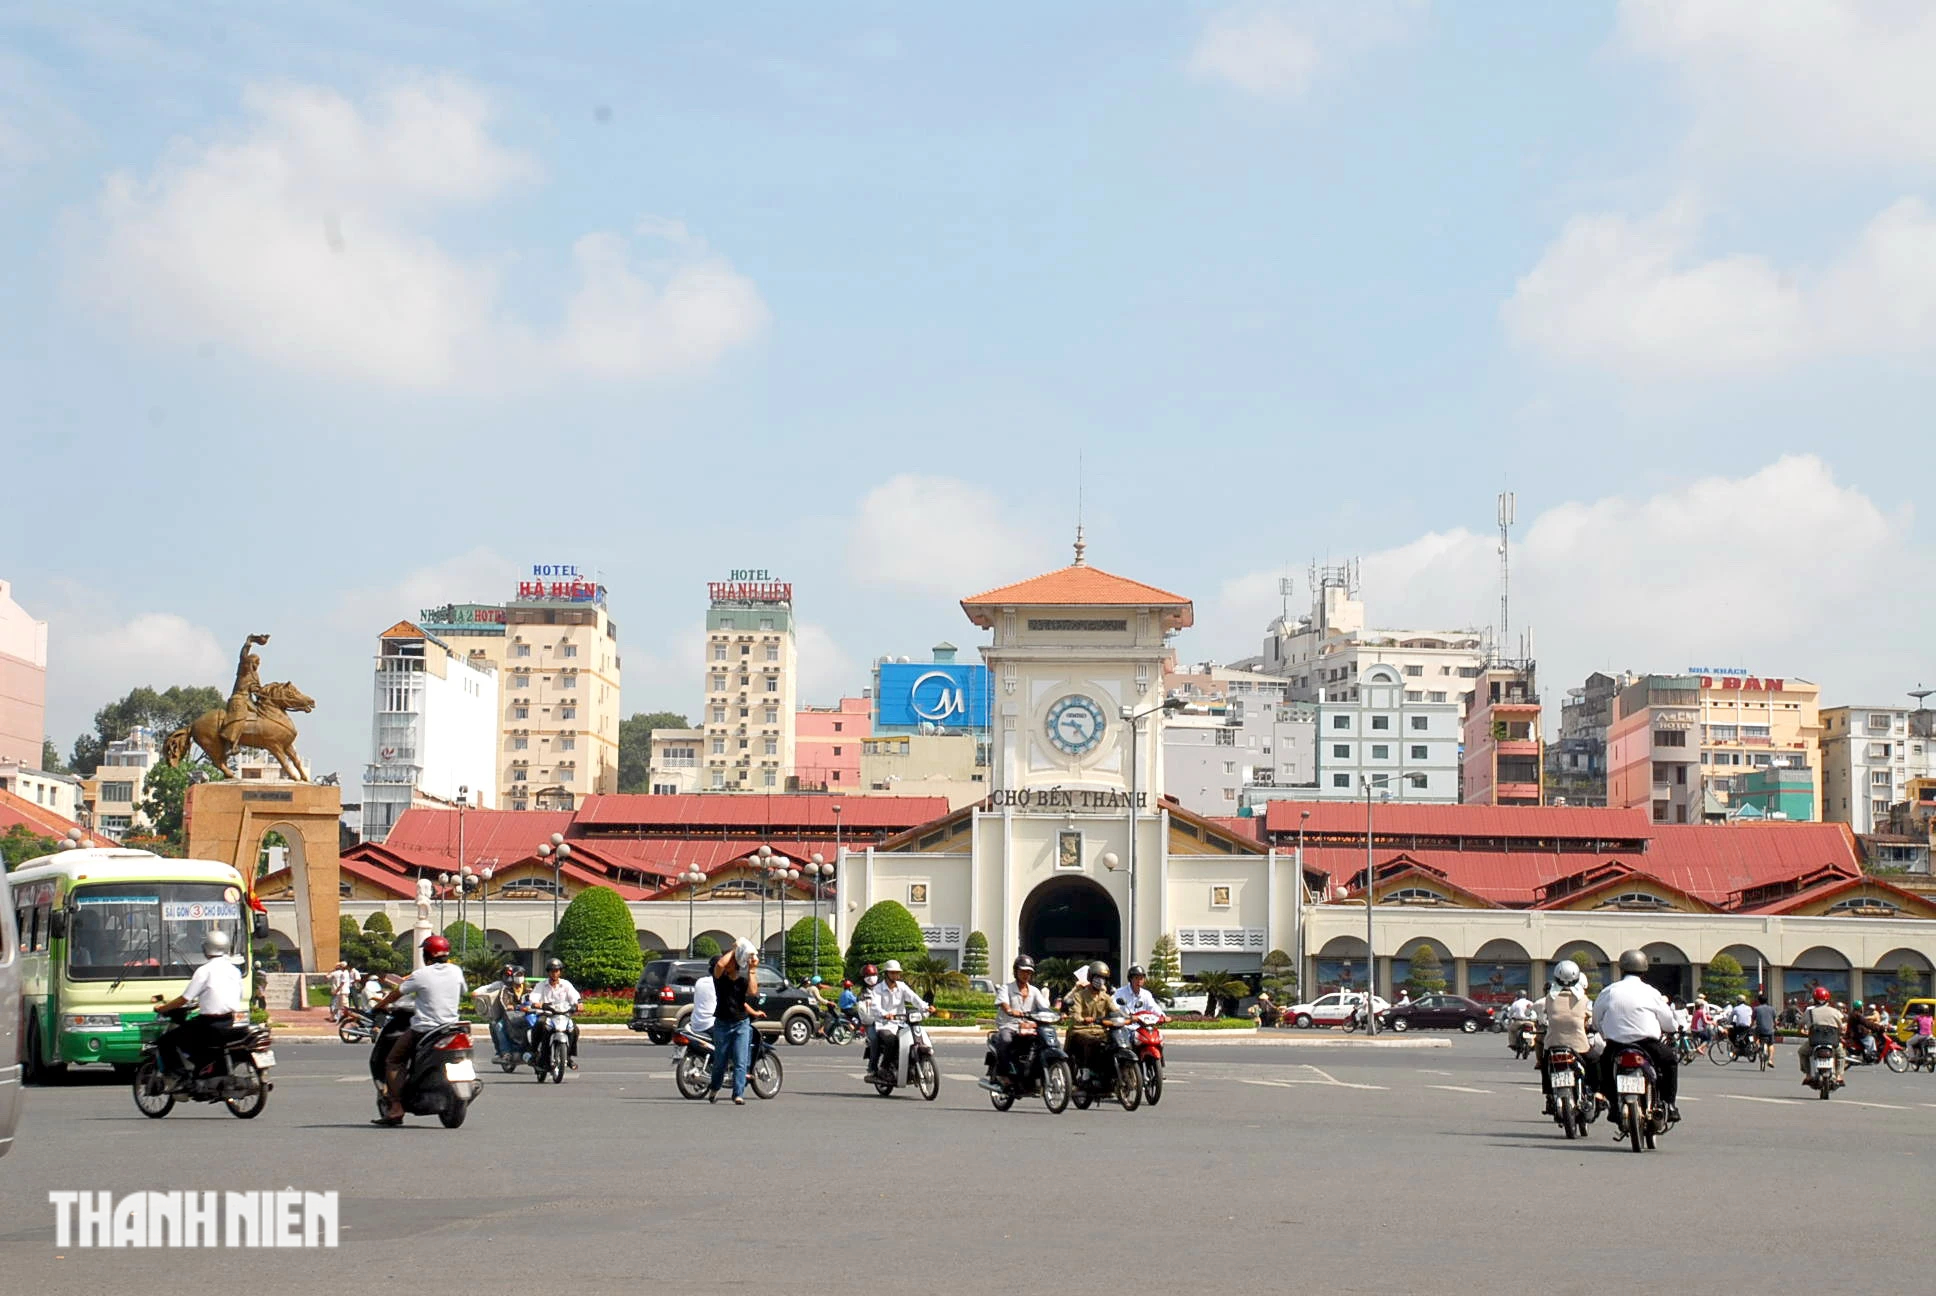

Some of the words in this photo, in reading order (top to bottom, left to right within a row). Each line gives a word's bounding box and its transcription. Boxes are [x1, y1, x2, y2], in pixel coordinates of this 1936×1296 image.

[533, 565, 577, 576] HOTEL
[731, 569, 771, 580] HOTEL
[993, 788, 1030, 807] CHỢ
[1037, 785, 1073, 807] BẾN
[1080, 787, 1147, 808] THÀNH
